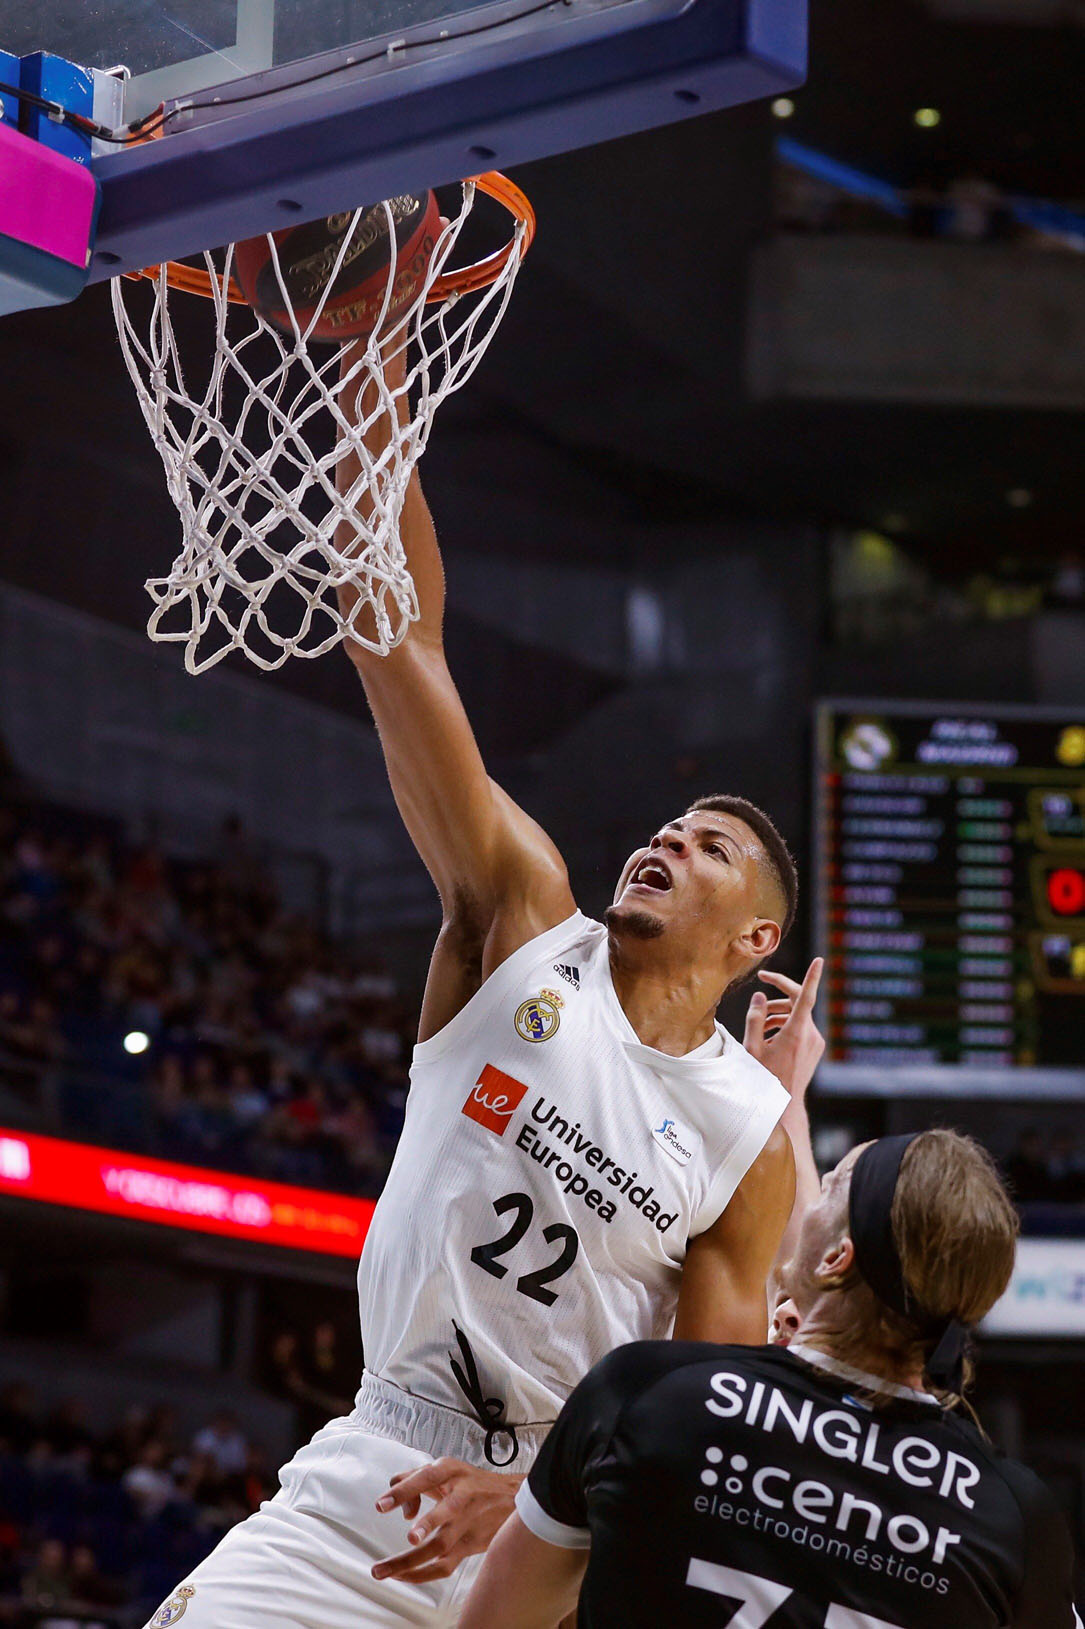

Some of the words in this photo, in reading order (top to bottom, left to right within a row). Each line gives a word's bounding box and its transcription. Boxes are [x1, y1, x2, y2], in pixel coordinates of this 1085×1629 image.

[553, 964, 580, 991] adidas
[515, 1123, 618, 1224] Europea
[531, 1096, 679, 1235] Universidad
[470, 1192, 579, 1307] 22
[694, 1494, 950, 1595] electrodomésticos
[752, 1466, 961, 1565] cenor
